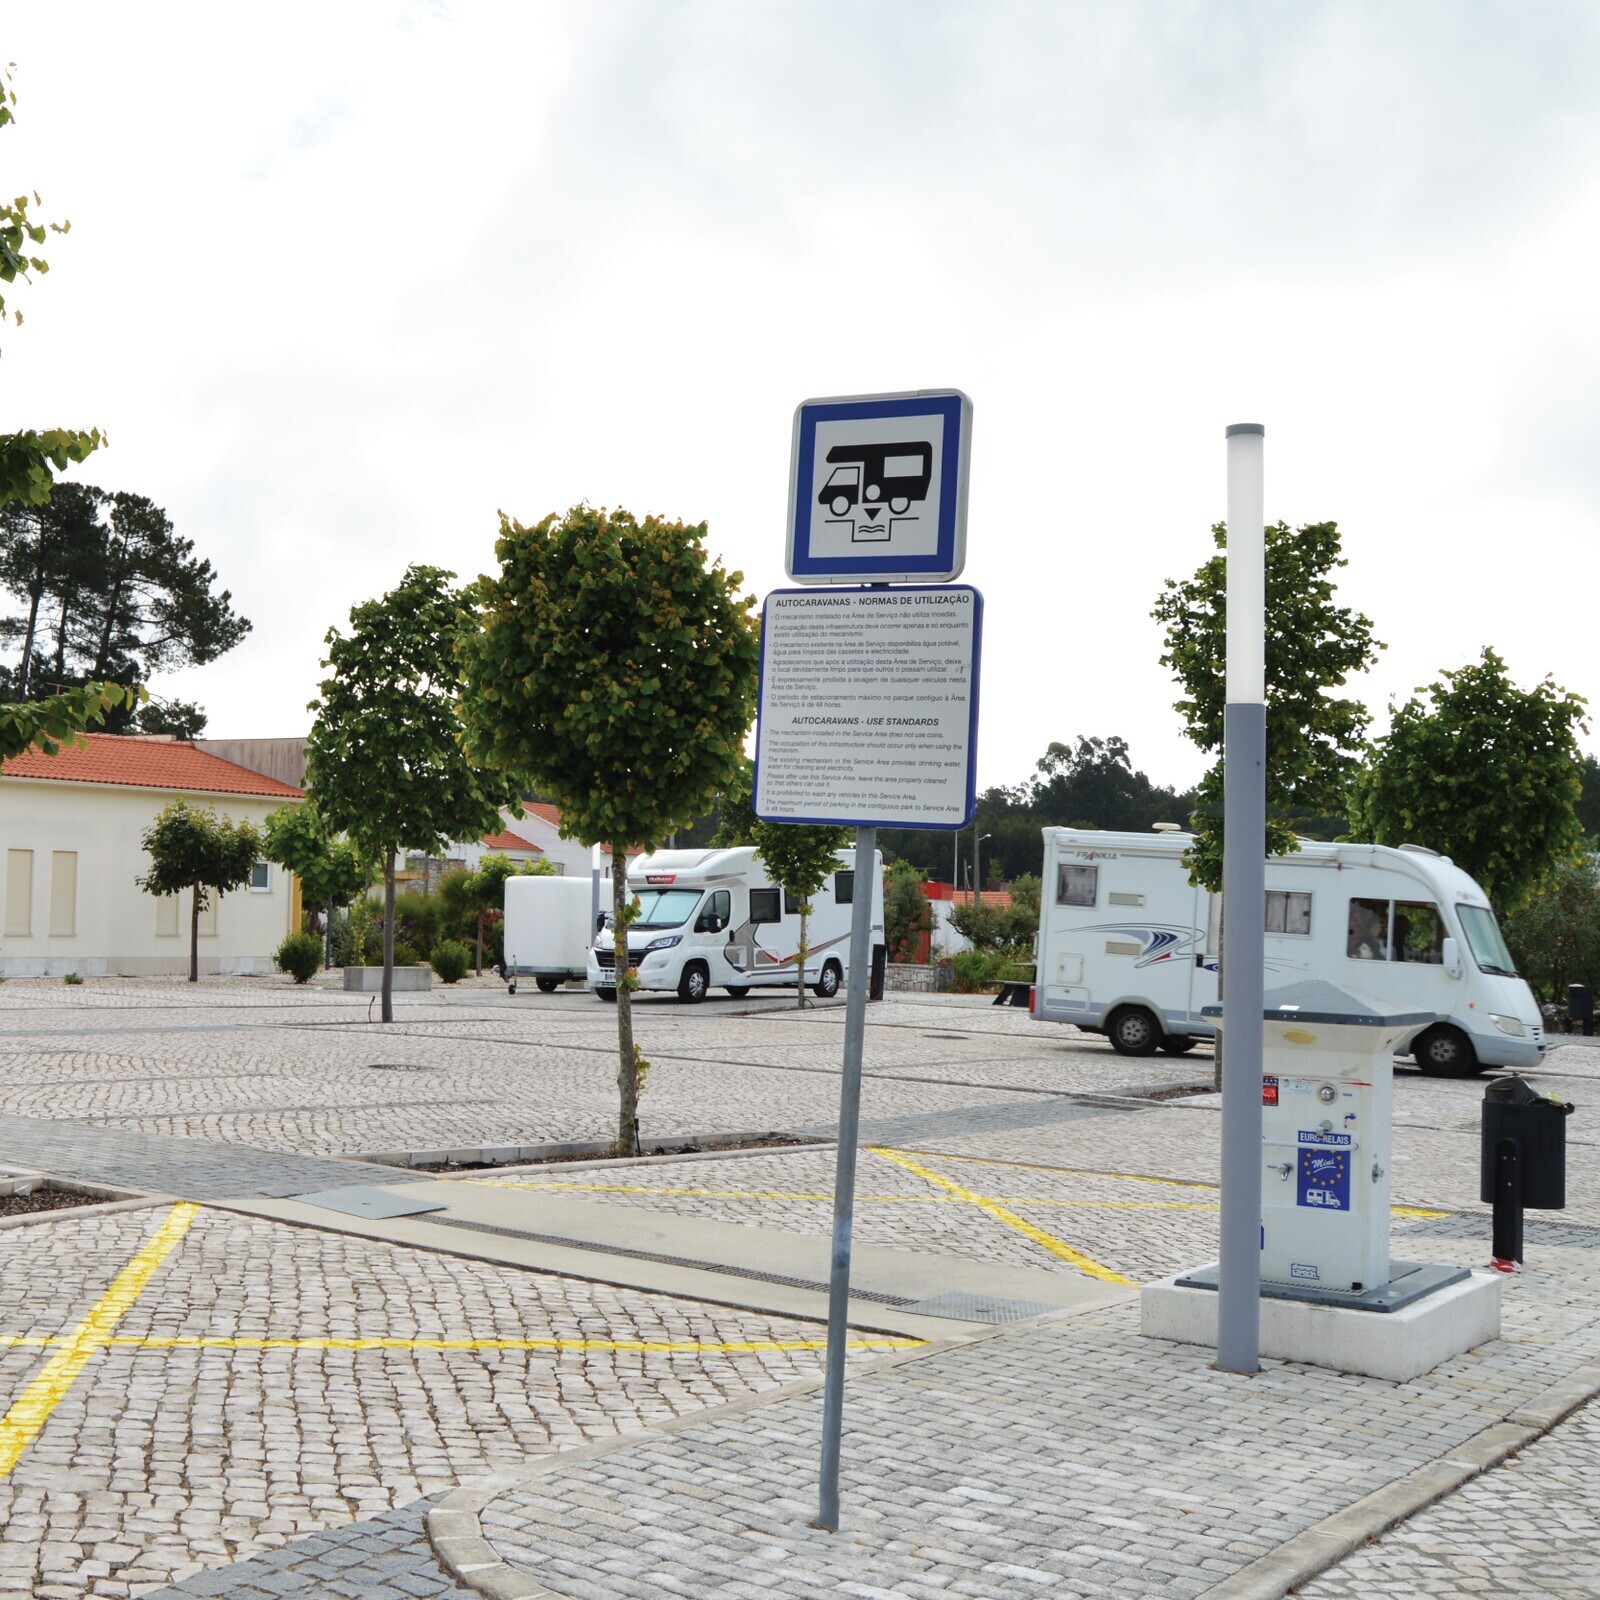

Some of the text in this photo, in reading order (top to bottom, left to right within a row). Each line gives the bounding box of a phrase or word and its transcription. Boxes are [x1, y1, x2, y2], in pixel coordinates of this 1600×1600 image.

[776, 598, 851, 606] AUTOCARAVANAS
[914, 594, 970, 605] UTILIZAÇÃO
[1076, 850, 1117, 860] FRANKIA
[1311, 1158, 1335, 1168] Mini
